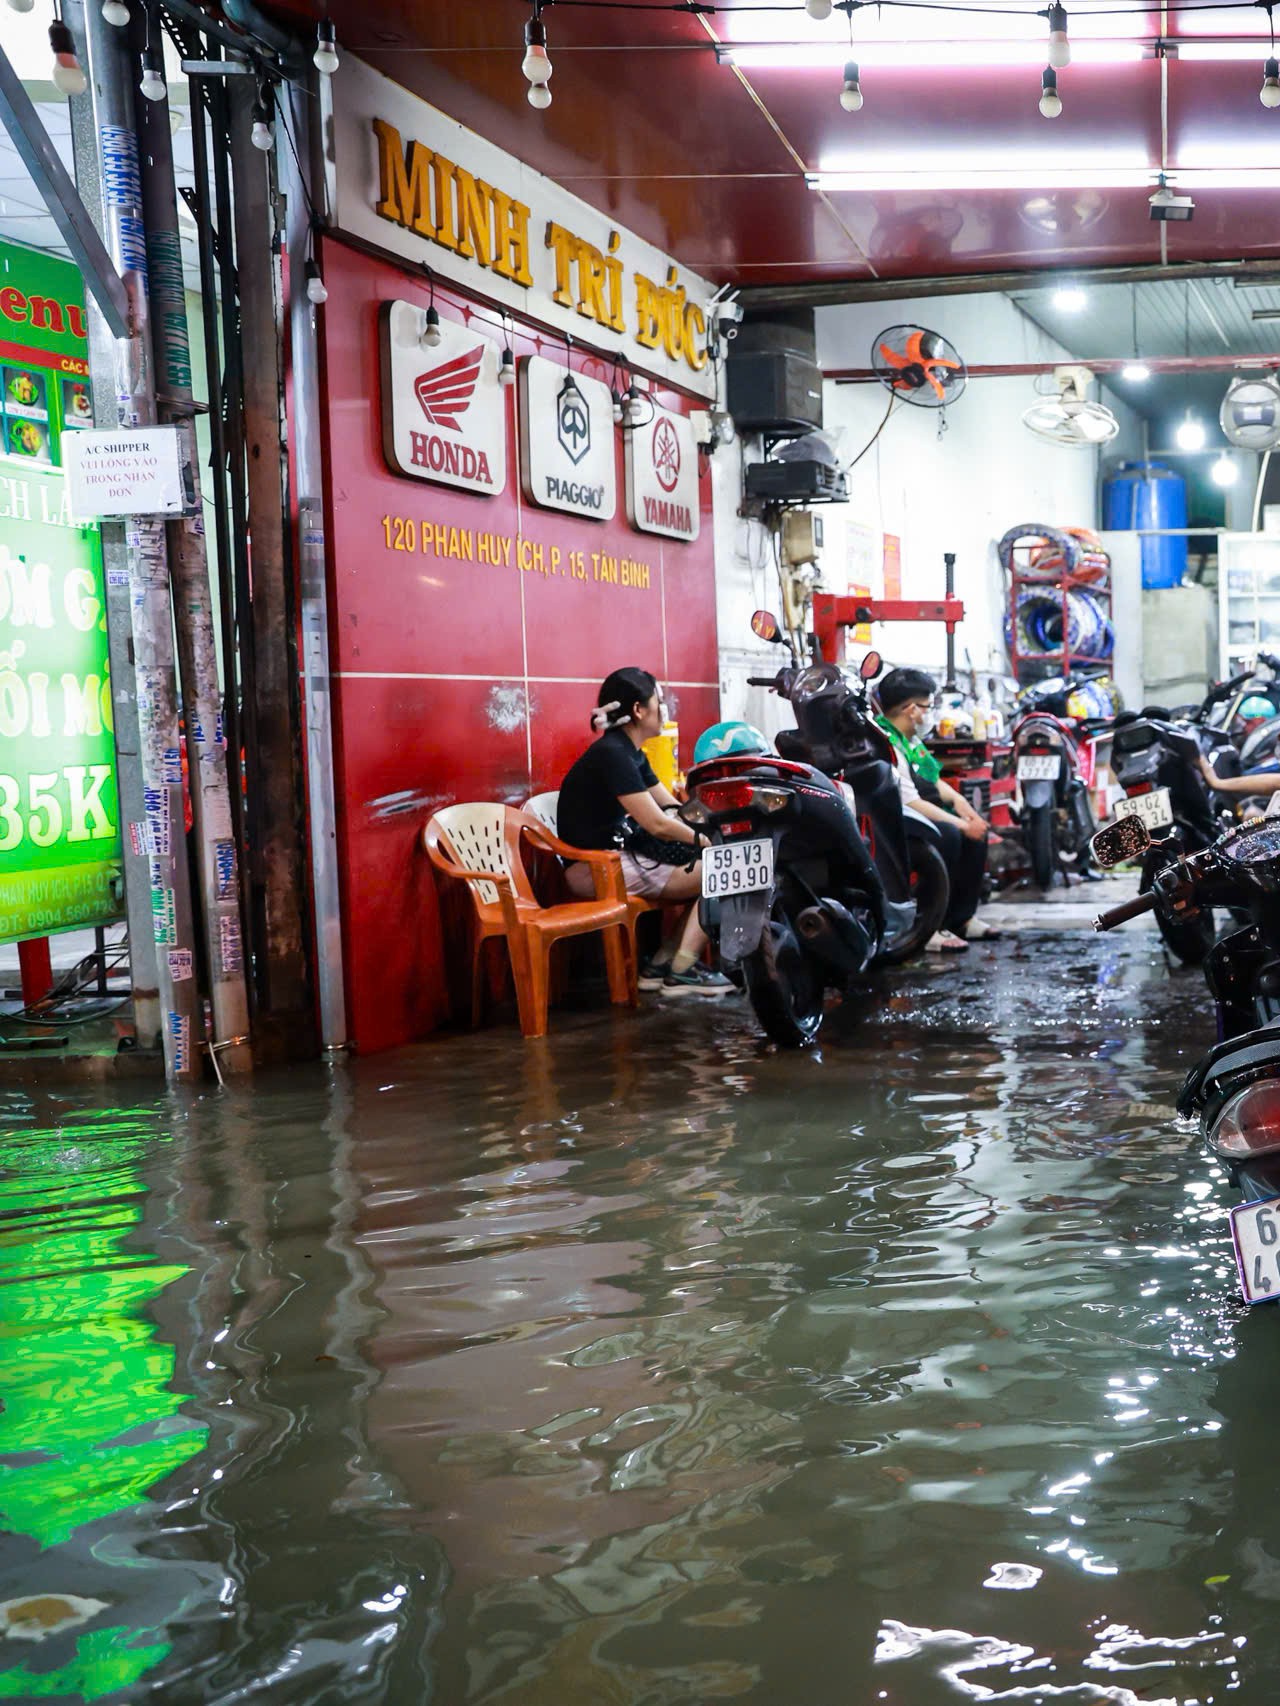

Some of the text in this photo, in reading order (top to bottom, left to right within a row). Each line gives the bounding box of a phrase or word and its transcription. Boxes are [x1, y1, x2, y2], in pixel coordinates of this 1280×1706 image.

[373, 118, 534, 288] MINH
[545, 229, 627, 335] TRÍ
[103, 442, 150, 454] SHIPPER
[410, 429, 493, 485] HONDA
[86, 473, 121, 485] TRONG
[545, 476, 601, 510] PIAGGIO
[643, 495, 692, 534] YAMAHA
[381, 514, 417, 552] 120
[421, 521, 474, 562] PHAN
[477, 532, 512, 569] HUY
[591, 549, 618, 584] TÂN
[621, 553, 651, 589] BÌNH
[0, 764, 116, 852] 35K
[714, 844, 762, 869] 59-V3
[708, 865, 768, 893] 099.90
